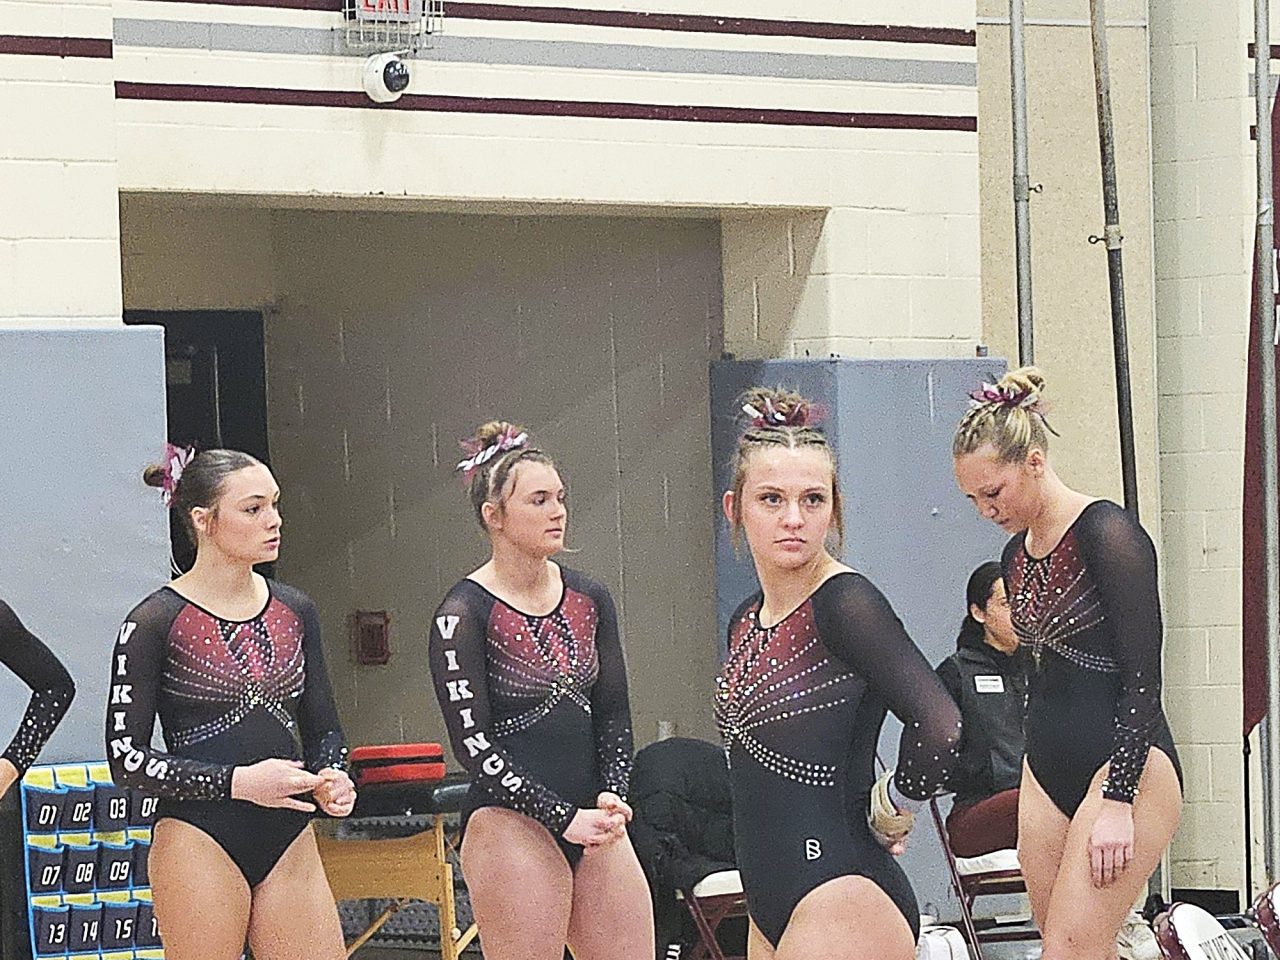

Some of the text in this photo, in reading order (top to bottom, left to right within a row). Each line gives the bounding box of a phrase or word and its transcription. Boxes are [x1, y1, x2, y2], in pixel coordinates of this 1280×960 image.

[109, 621, 169, 780] VIKINGS
[436, 615, 522, 792] VIKINGS
[38, 805, 58, 825] 01
[72, 802, 92, 822] 02
[109, 798, 127, 819] 03
[41, 861, 130, 885] 07 08 09
[48, 924, 66, 944] 13
[82, 921, 99, 942] 14
[114, 919, 133, 939] 15
